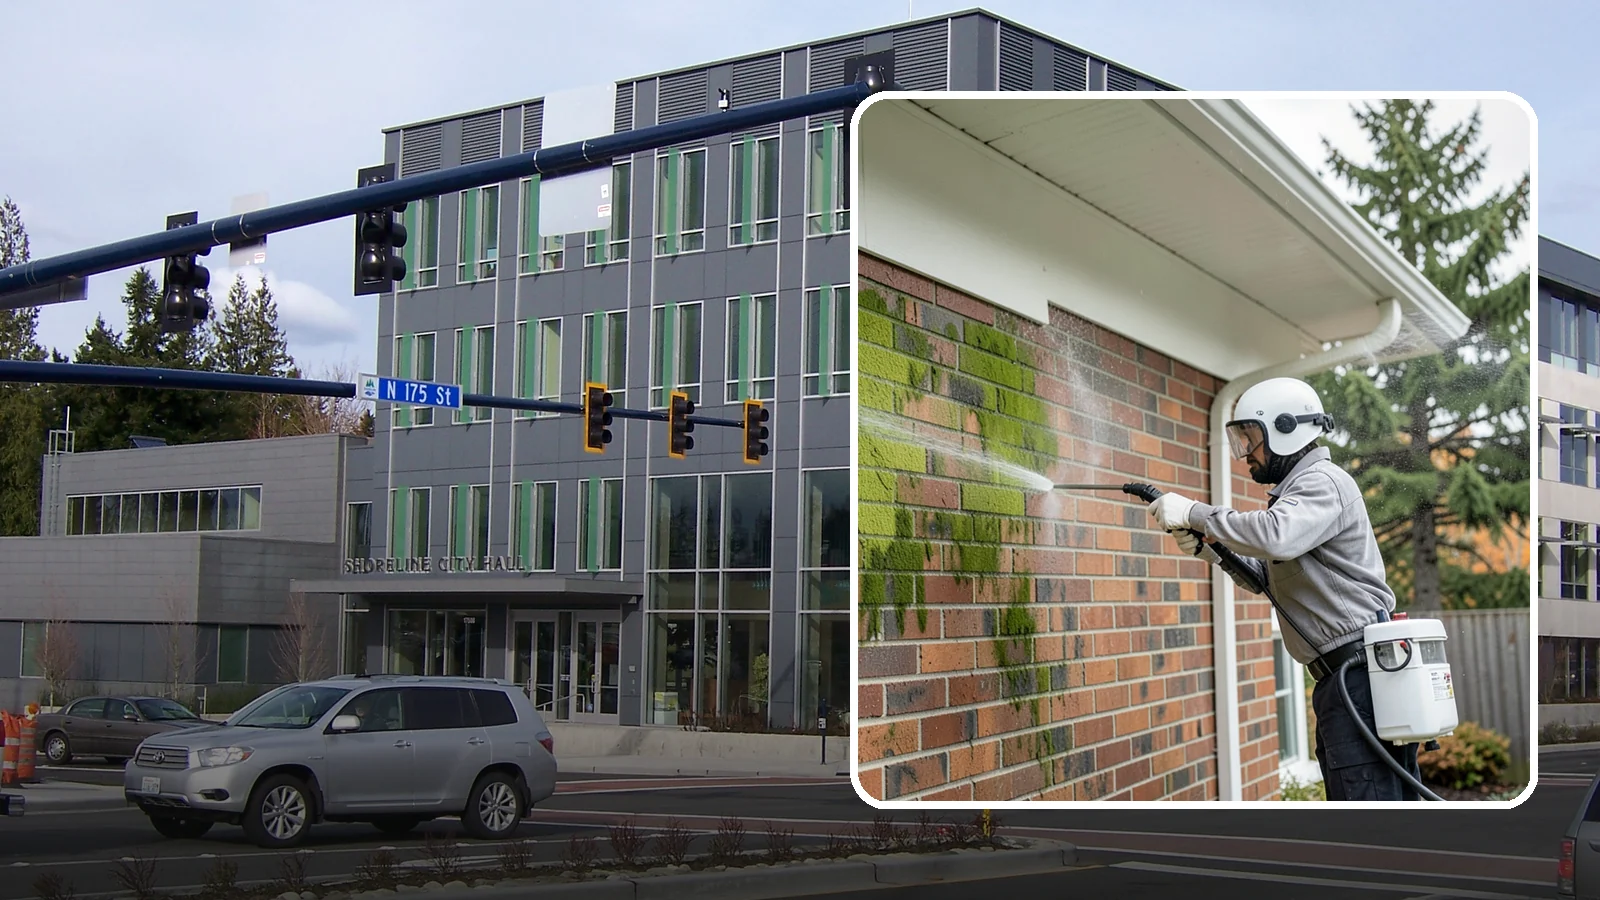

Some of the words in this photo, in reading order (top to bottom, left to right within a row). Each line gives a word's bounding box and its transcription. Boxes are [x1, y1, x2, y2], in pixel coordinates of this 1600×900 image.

[387, 380, 396, 400] N
[405, 382, 427, 403] 175
[436, 386, 451, 406] St
[343, 556, 433, 574] SHORELINE
[438, 556, 476, 573] CITY
[483, 555, 526, 572] HALL
